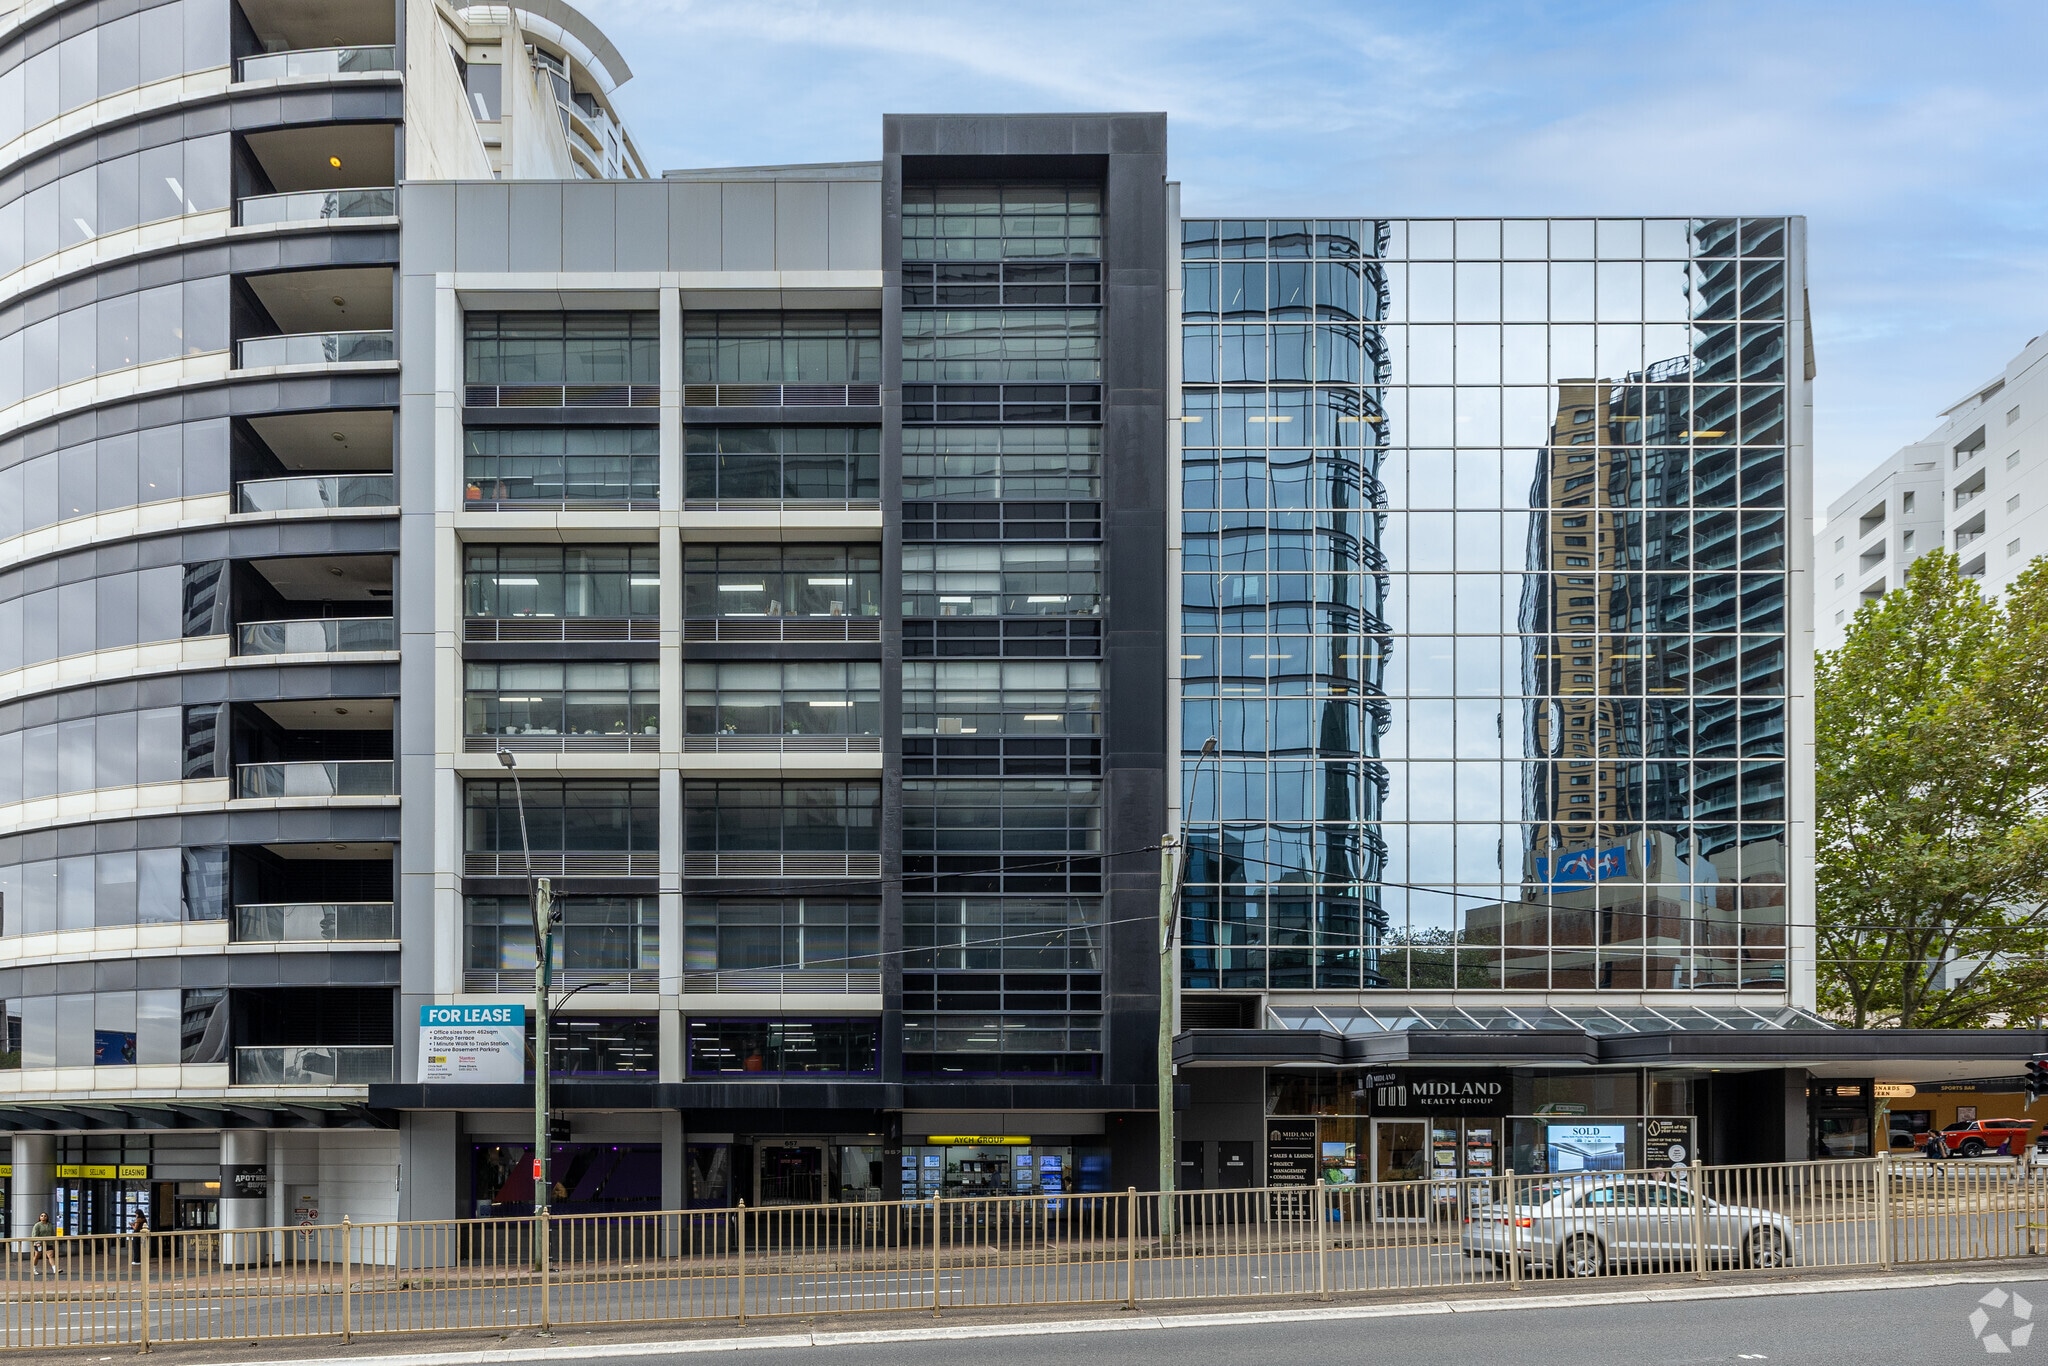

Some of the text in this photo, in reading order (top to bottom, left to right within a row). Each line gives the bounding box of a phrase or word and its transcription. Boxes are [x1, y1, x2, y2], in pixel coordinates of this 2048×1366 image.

[429, 1009, 511, 1022] FOR LEASE
[1412, 1082, 1502, 1096] MIDLAND
[1572, 1128, 1600, 1136] SOLD
